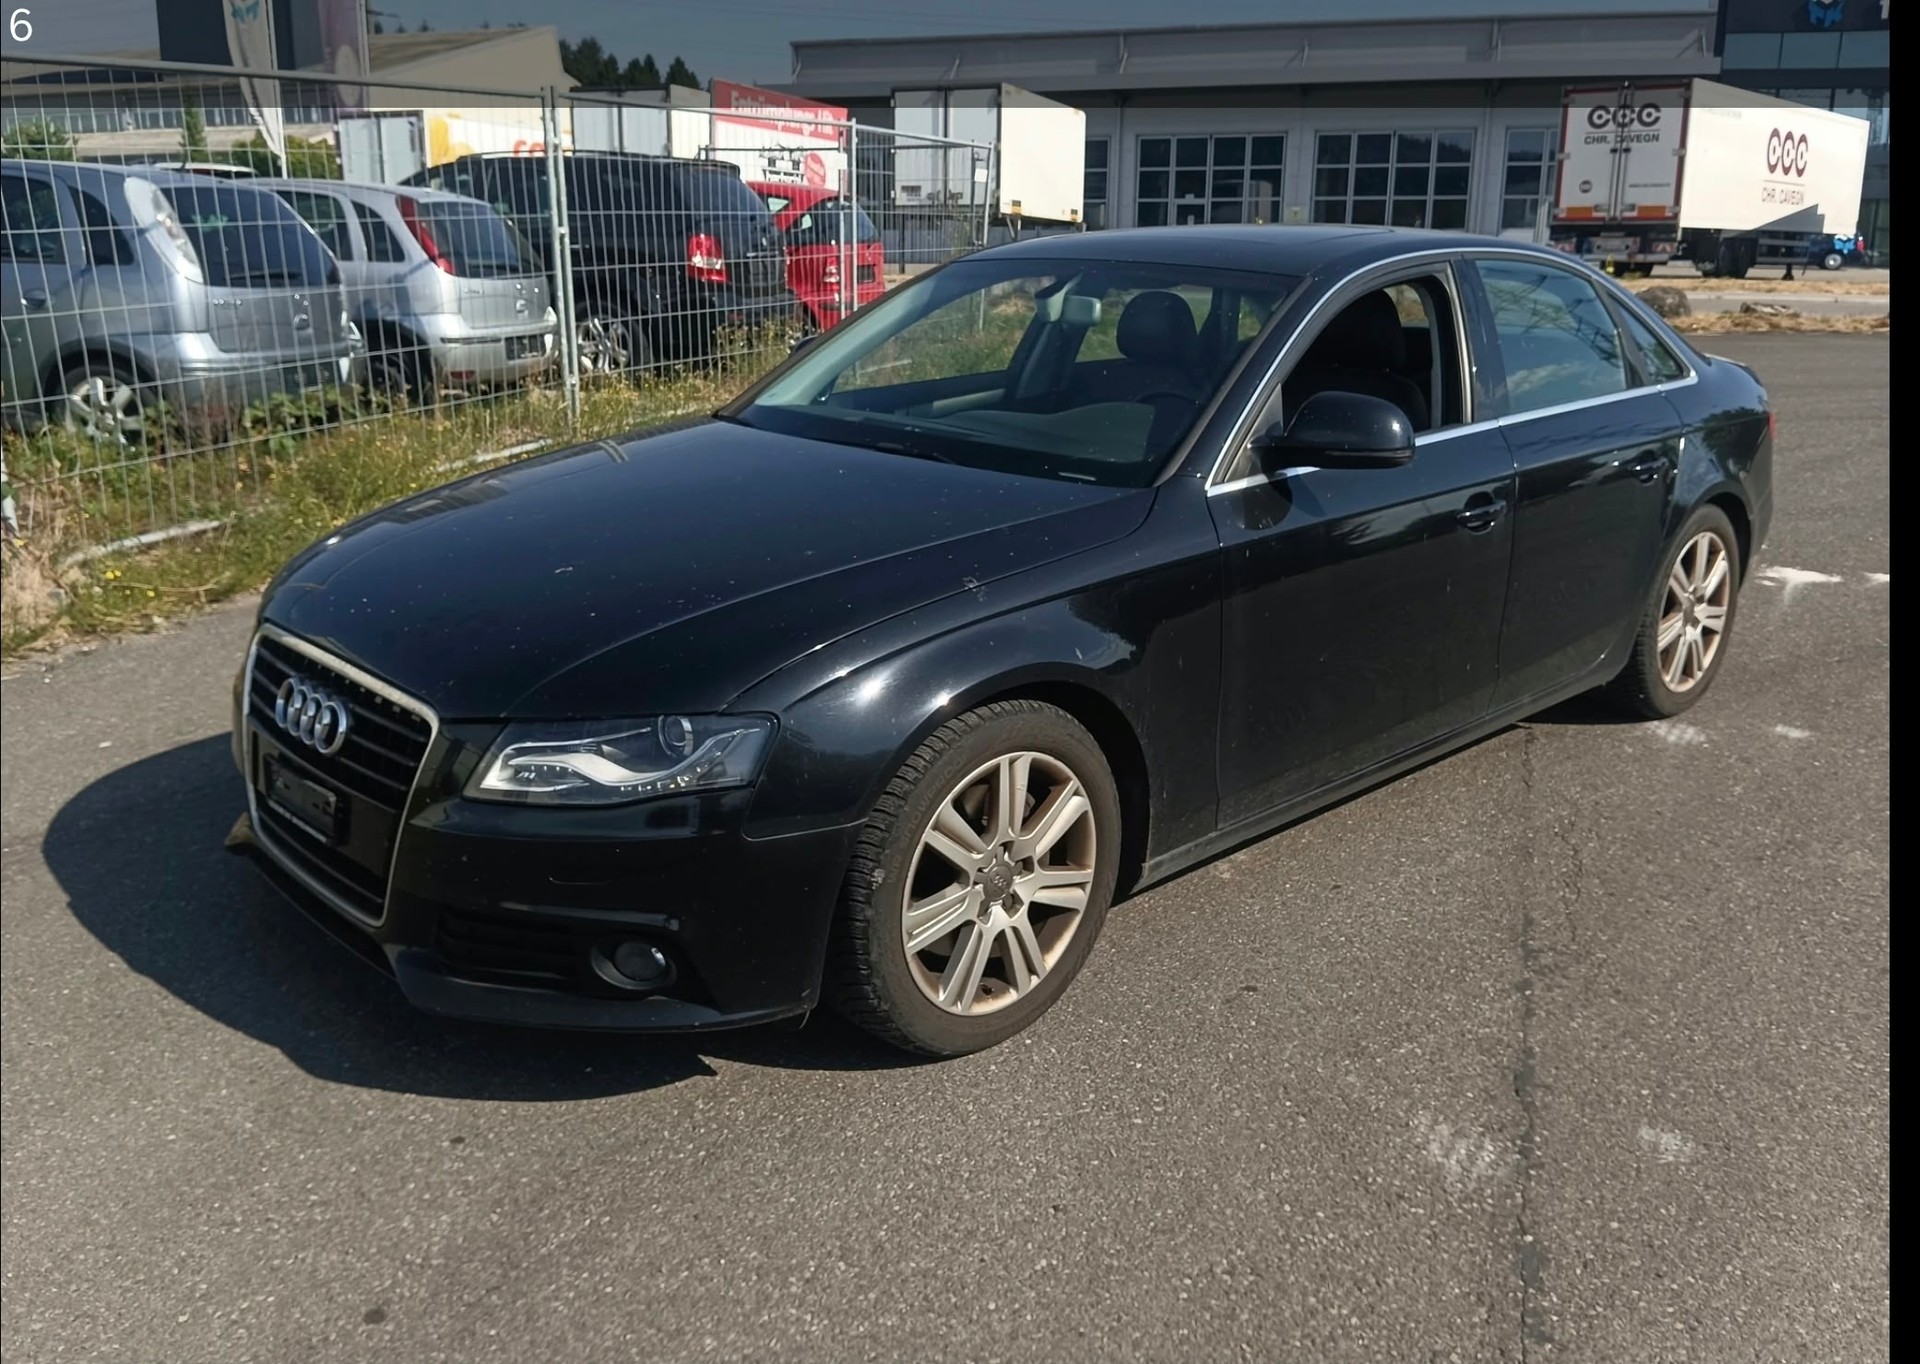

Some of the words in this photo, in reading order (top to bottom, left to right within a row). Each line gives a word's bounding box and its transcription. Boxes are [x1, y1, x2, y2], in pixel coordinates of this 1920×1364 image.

[1588, 103, 1661, 129] CCC
[1584, 134, 1610, 146] CHR.
[1767, 127, 1809, 178] CCC
